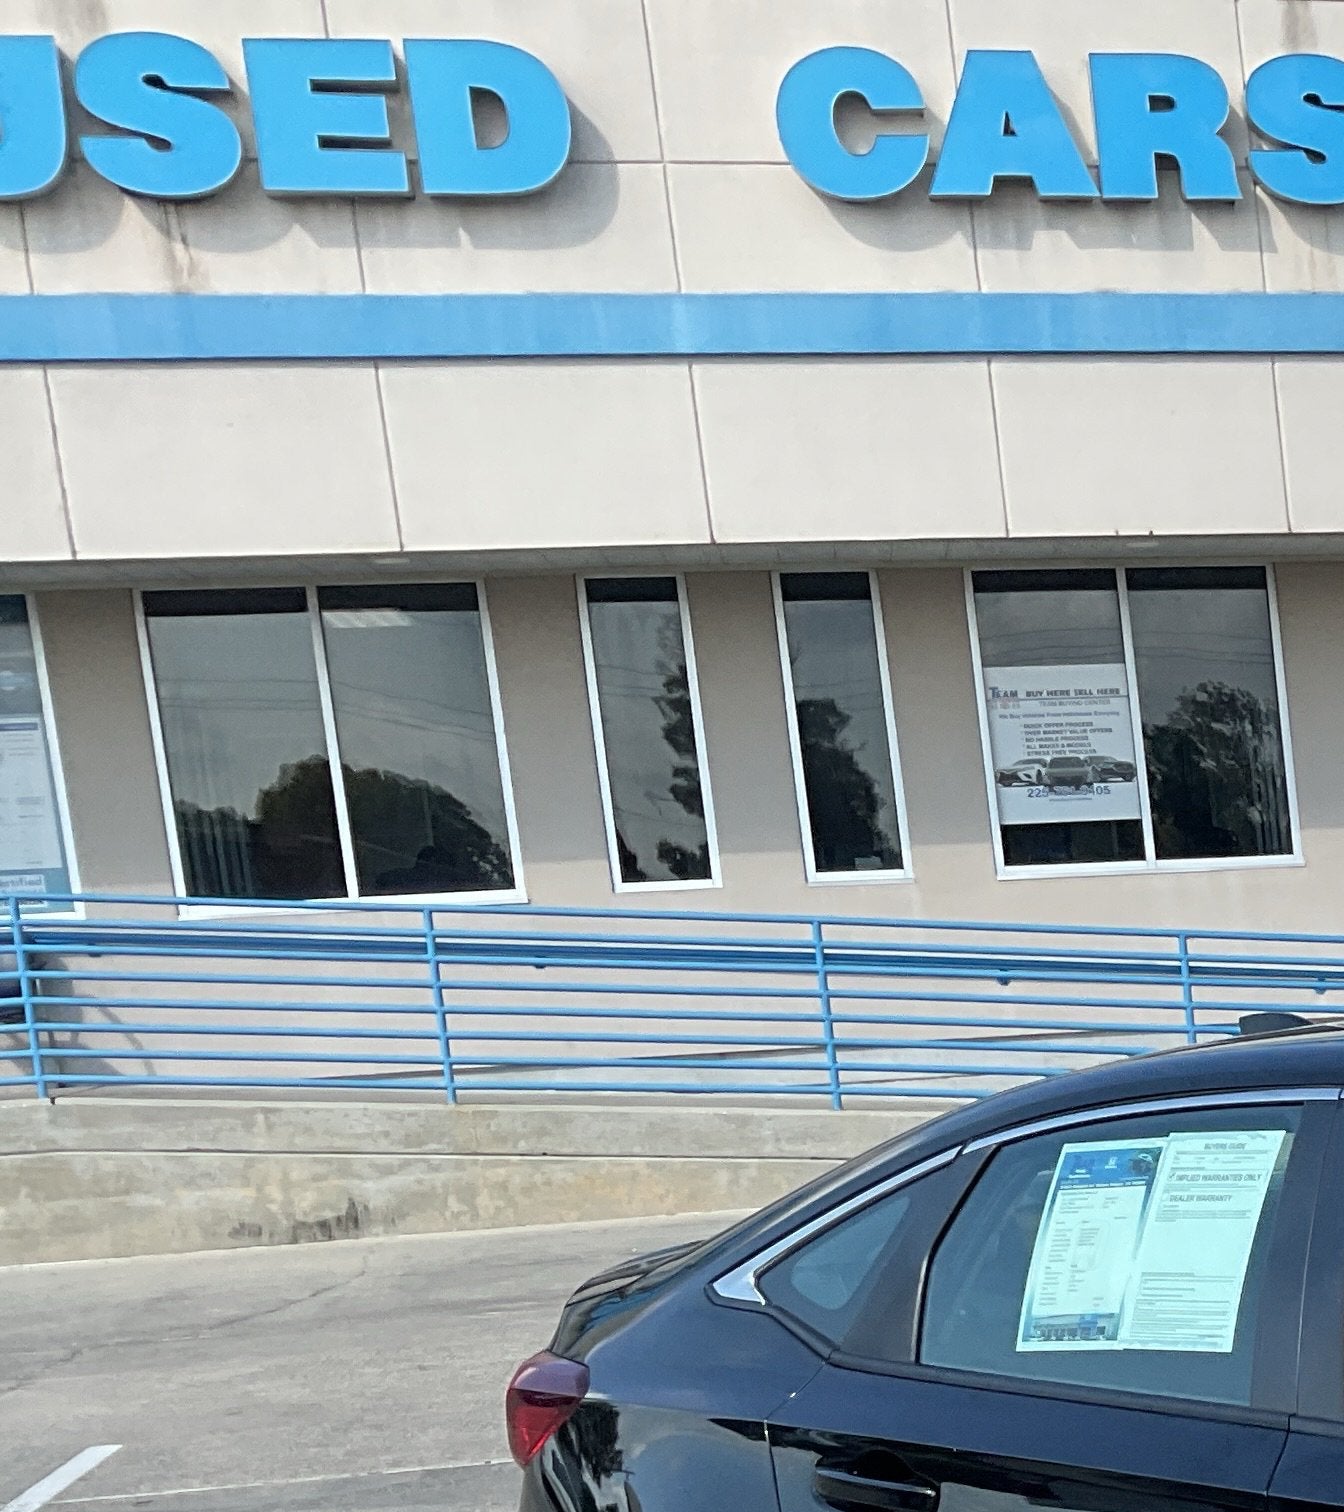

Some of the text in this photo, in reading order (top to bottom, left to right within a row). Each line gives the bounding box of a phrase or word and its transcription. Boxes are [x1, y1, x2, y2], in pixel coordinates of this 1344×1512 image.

[1074, 688, 1093, 696] SELL
[1096, 687, 1120, 695] HERE
[1176, 1173, 1262, 1182] IMPLIED WARRANTIES ONLY
[1169, 1194, 1232, 1202] DEALER WARRANTY
